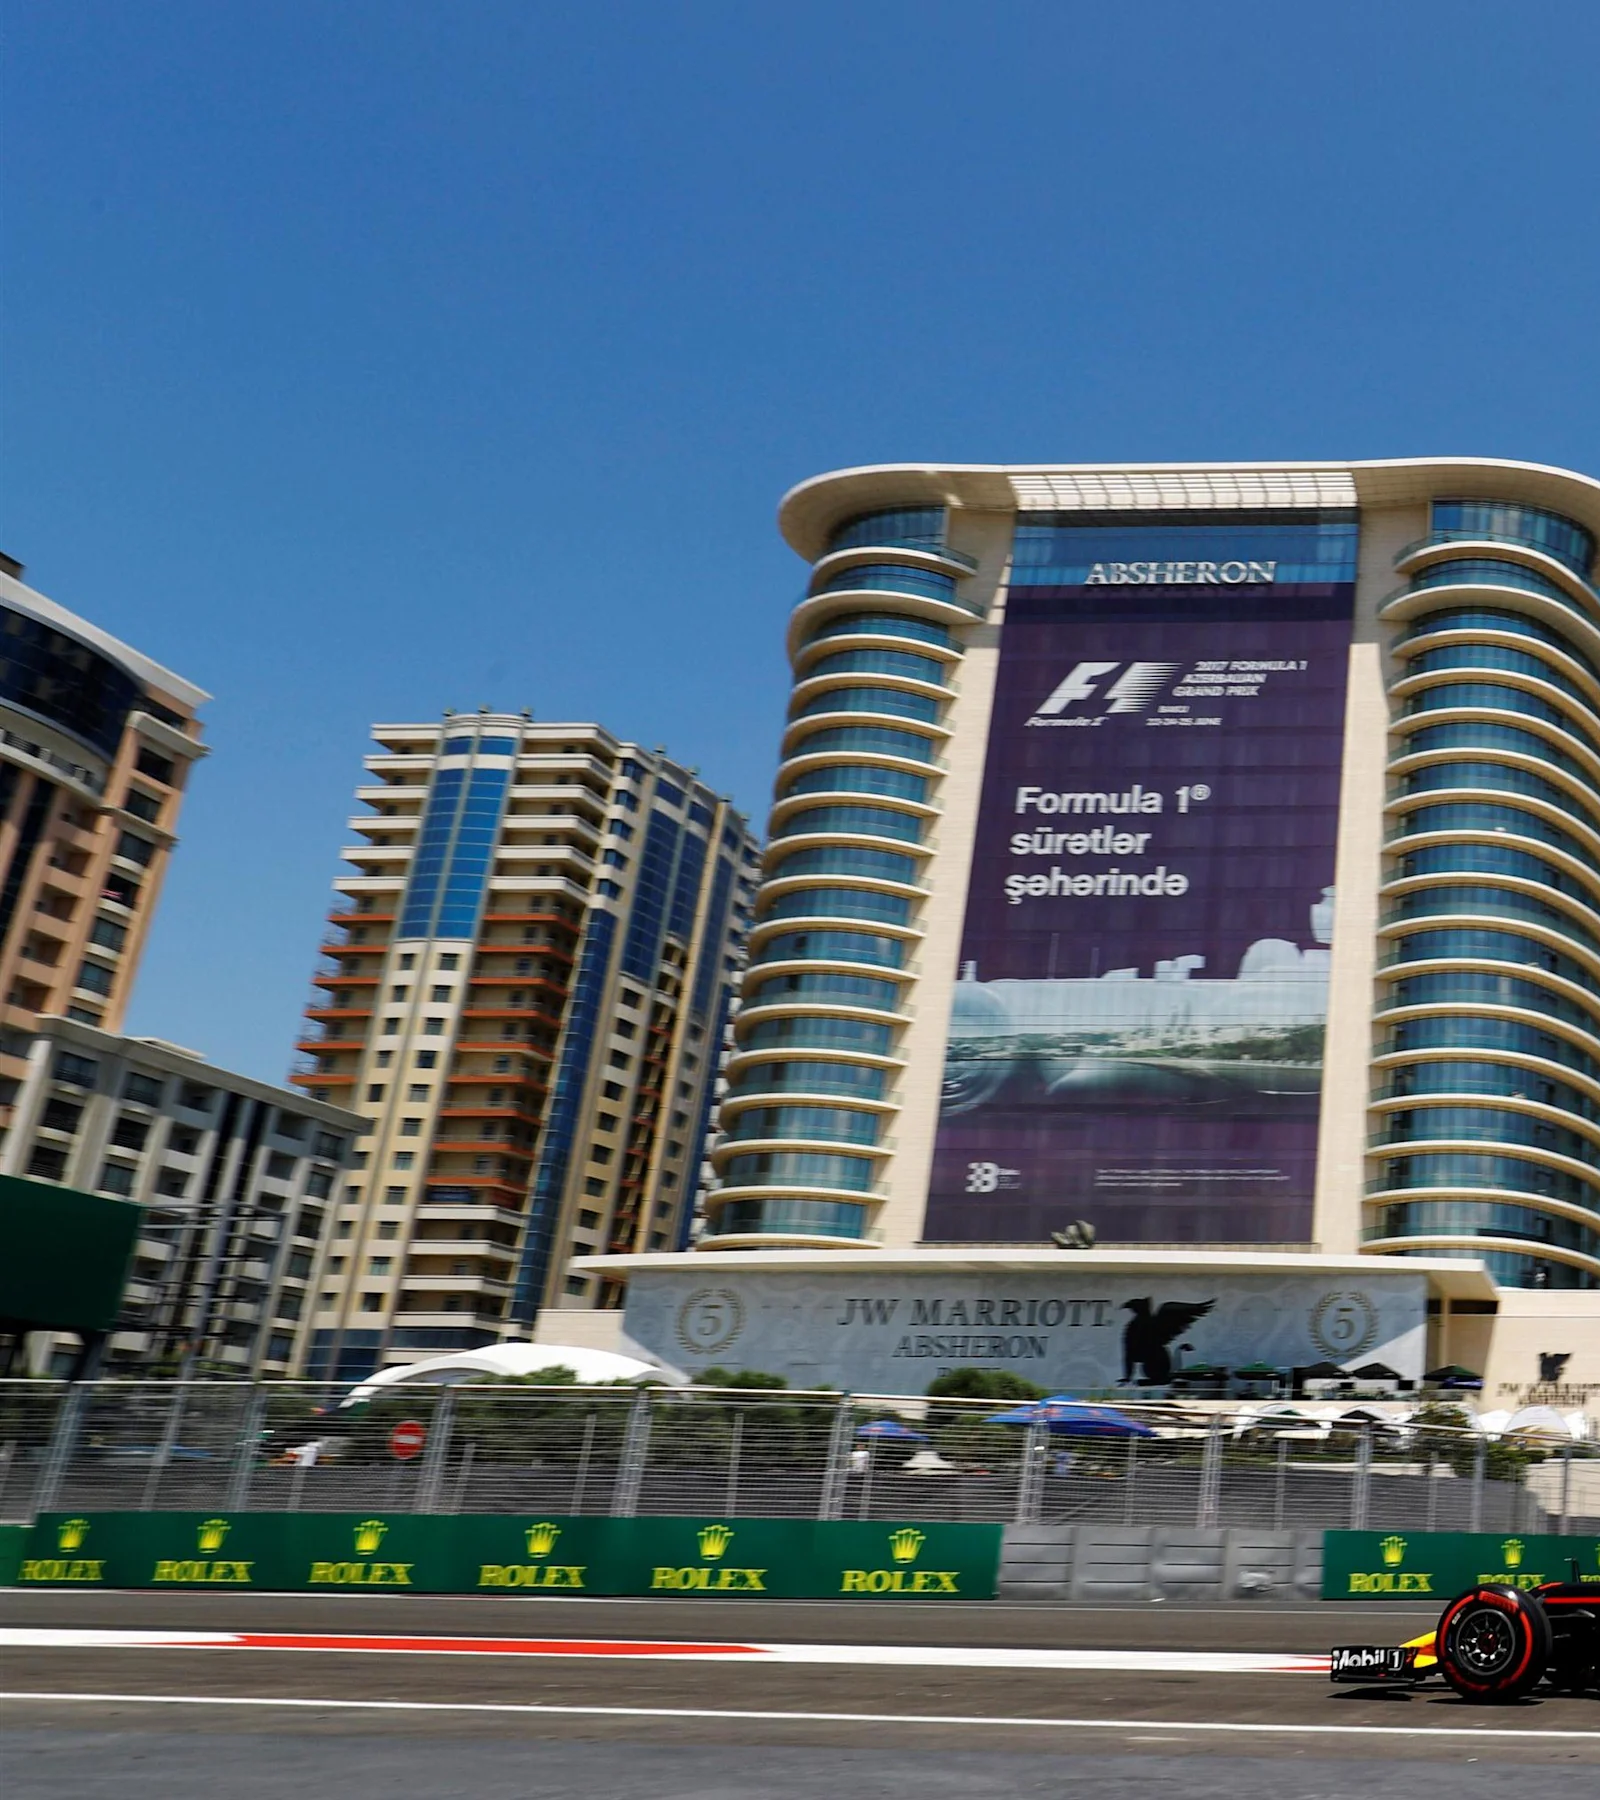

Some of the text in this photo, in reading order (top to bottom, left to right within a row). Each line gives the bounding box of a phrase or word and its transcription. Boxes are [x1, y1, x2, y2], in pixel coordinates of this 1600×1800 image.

[1084, 560, 1278, 585] ABSHERON
[1229, 660, 1298, 672] FORMULA
[1172, 685, 1261, 697] GRAND PRIX
[1015, 784, 1163, 814] Formula
[1009, 825, 1152, 855] sürətlər
[1004, 866, 1190, 905] şəhərində
[696, 1304, 723, 1336] 5
[837, 1298, 1114, 1327] JW MARRIOTT
[1331, 1307, 1356, 1340] 5
[892, 1335, 1050, 1358] ABSHERON
[18, 1560, 107, 1581] ROLEX
[151, 1560, 256, 1582] ROLEX
[306, 1562, 415, 1585] ROLEX
[476, 1564, 588, 1587] ROLEX
[650, 1567, 769, 1591] ROLEX
[839, 1570, 961, 1593] ROLEX
[1348, 1573, 1434, 1593] ROLEX
[1333, 1649, 1385, 1670] Mobil
